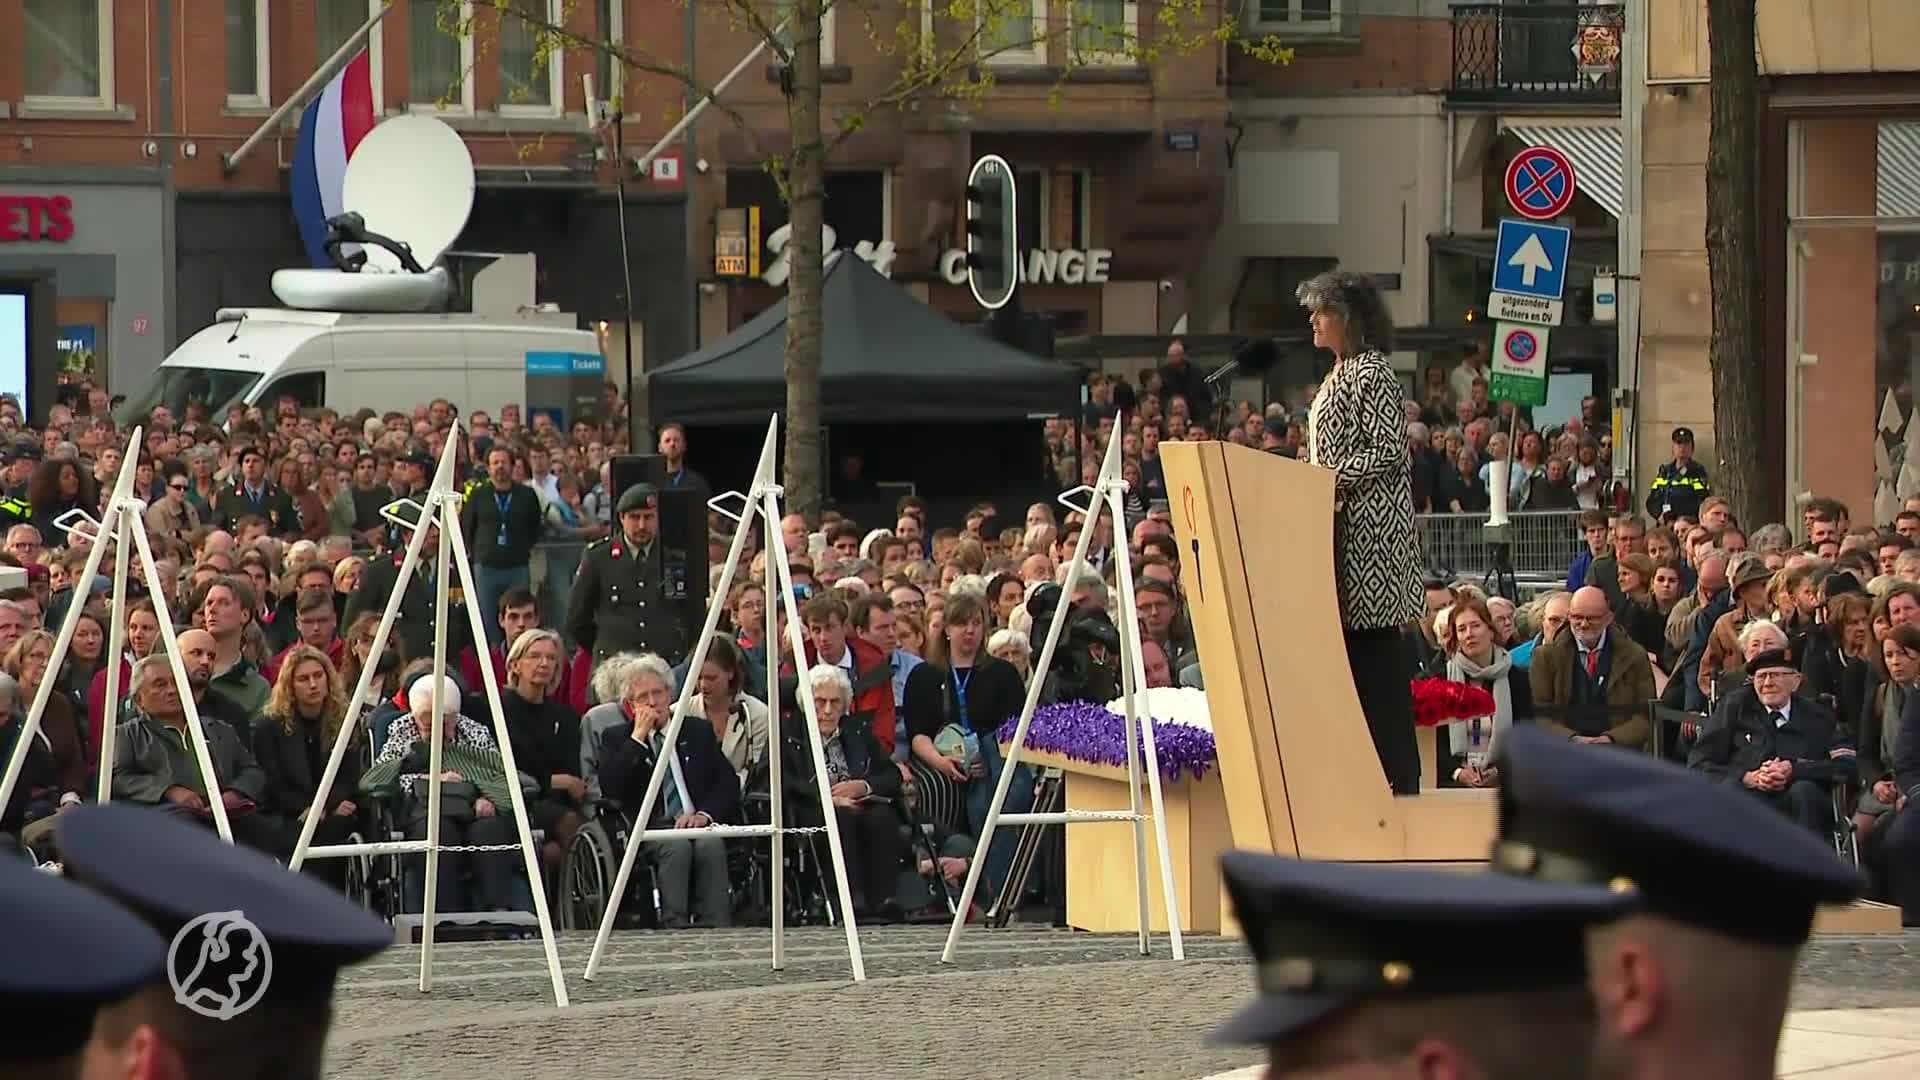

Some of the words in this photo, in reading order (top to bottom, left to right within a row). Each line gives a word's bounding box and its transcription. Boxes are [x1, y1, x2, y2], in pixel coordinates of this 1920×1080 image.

[0, 195, 74, 242] ETS
[718, 259, 745, 272] ATM
[939, 248, 1112, 284] CNGE
[1502, 296, 1550, 309] uitgezonderd
[1501, 307, 1529, 320] fietsers
[1531, 313, 1540, 321] en
[1542, 312, 1553, 323] OV
[572, 359, 601, 369] Tickets
